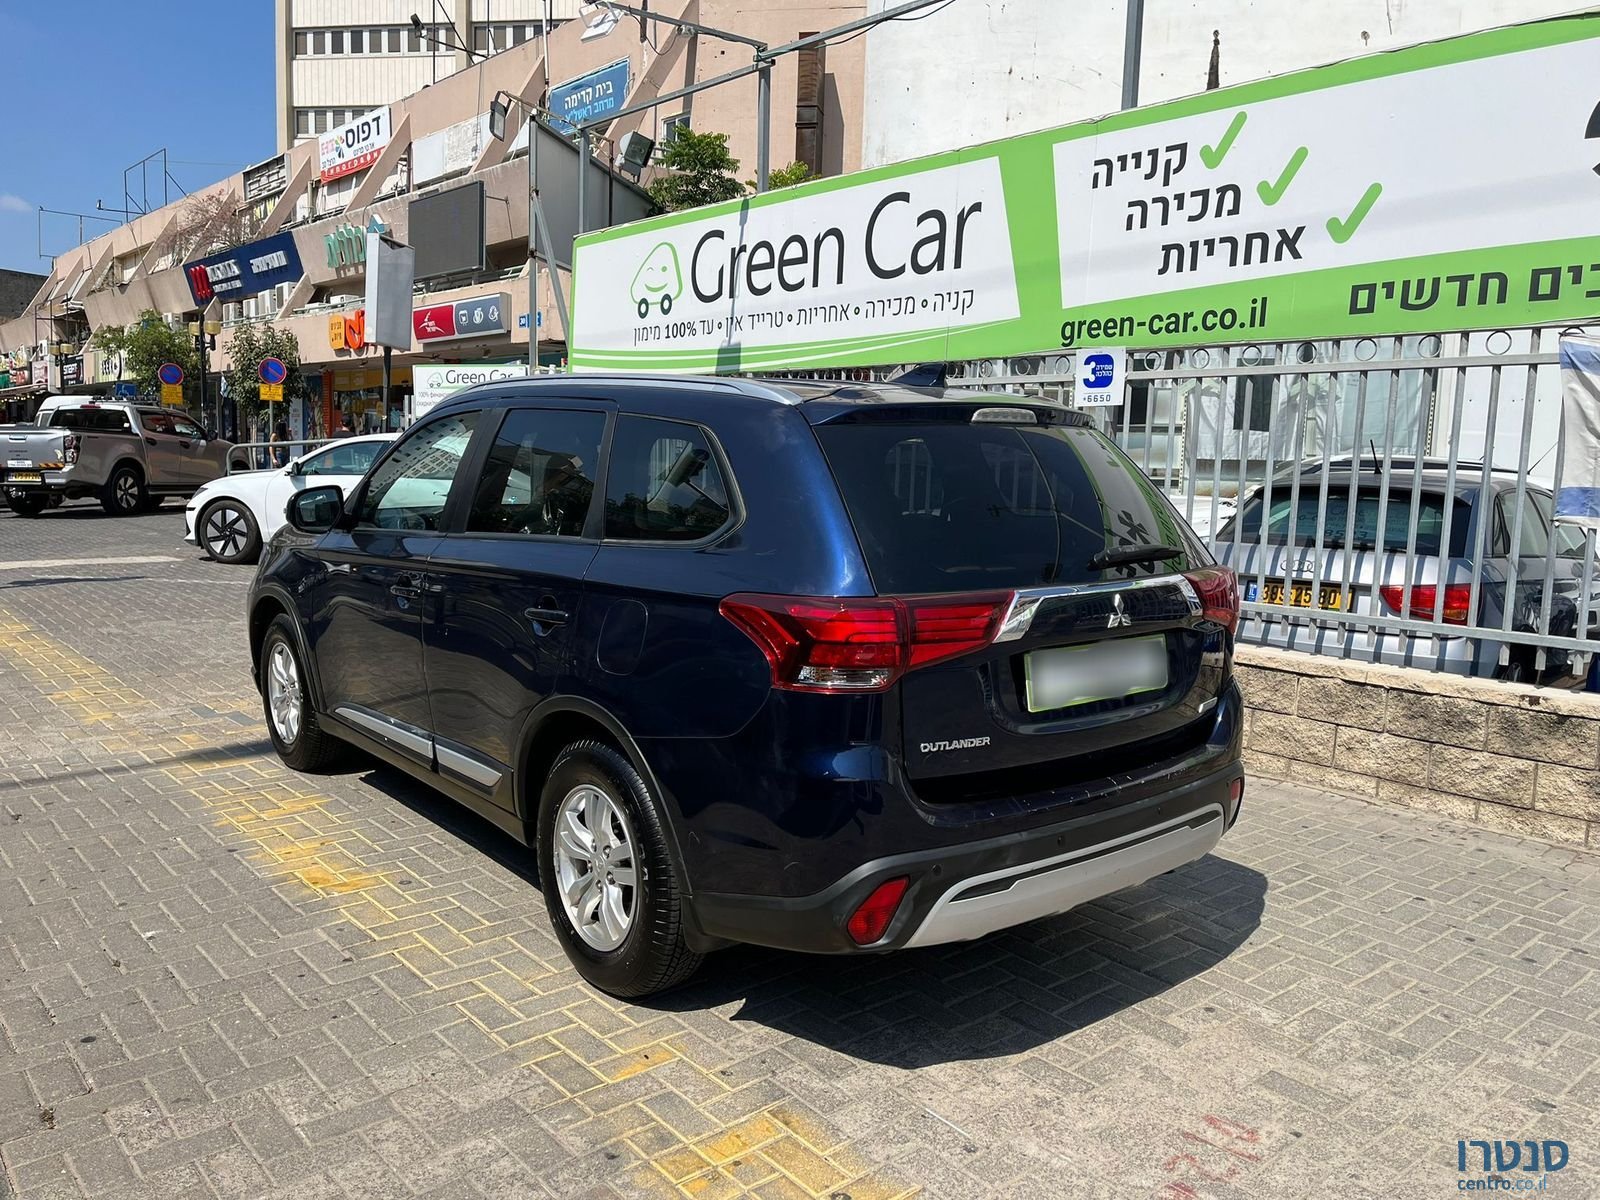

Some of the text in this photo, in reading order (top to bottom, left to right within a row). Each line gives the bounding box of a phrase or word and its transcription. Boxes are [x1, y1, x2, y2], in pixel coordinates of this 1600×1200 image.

[594, 97, 614, 113] מרחב
[595, 80, 613, 98] בית
[345, 116, 381, 149] דפוס
[1091, 142, 1188, 189] קנייה
[1125, 183, 1242, 231] מכירה
[690, 191, 982, 304] Green Car
[1157, 225, 1306, 275] אחריות
[1348, 271, 1508, 315] חדשים
[633, 288, 975, 346] קניה מכירה אחריות טרייד אין עד 100% מימון
[1060, 297, 1267, 348] green-car.co.il
[445, 369, 486, 384] Green
[920, 736, 991, 753] OUTLANDER
